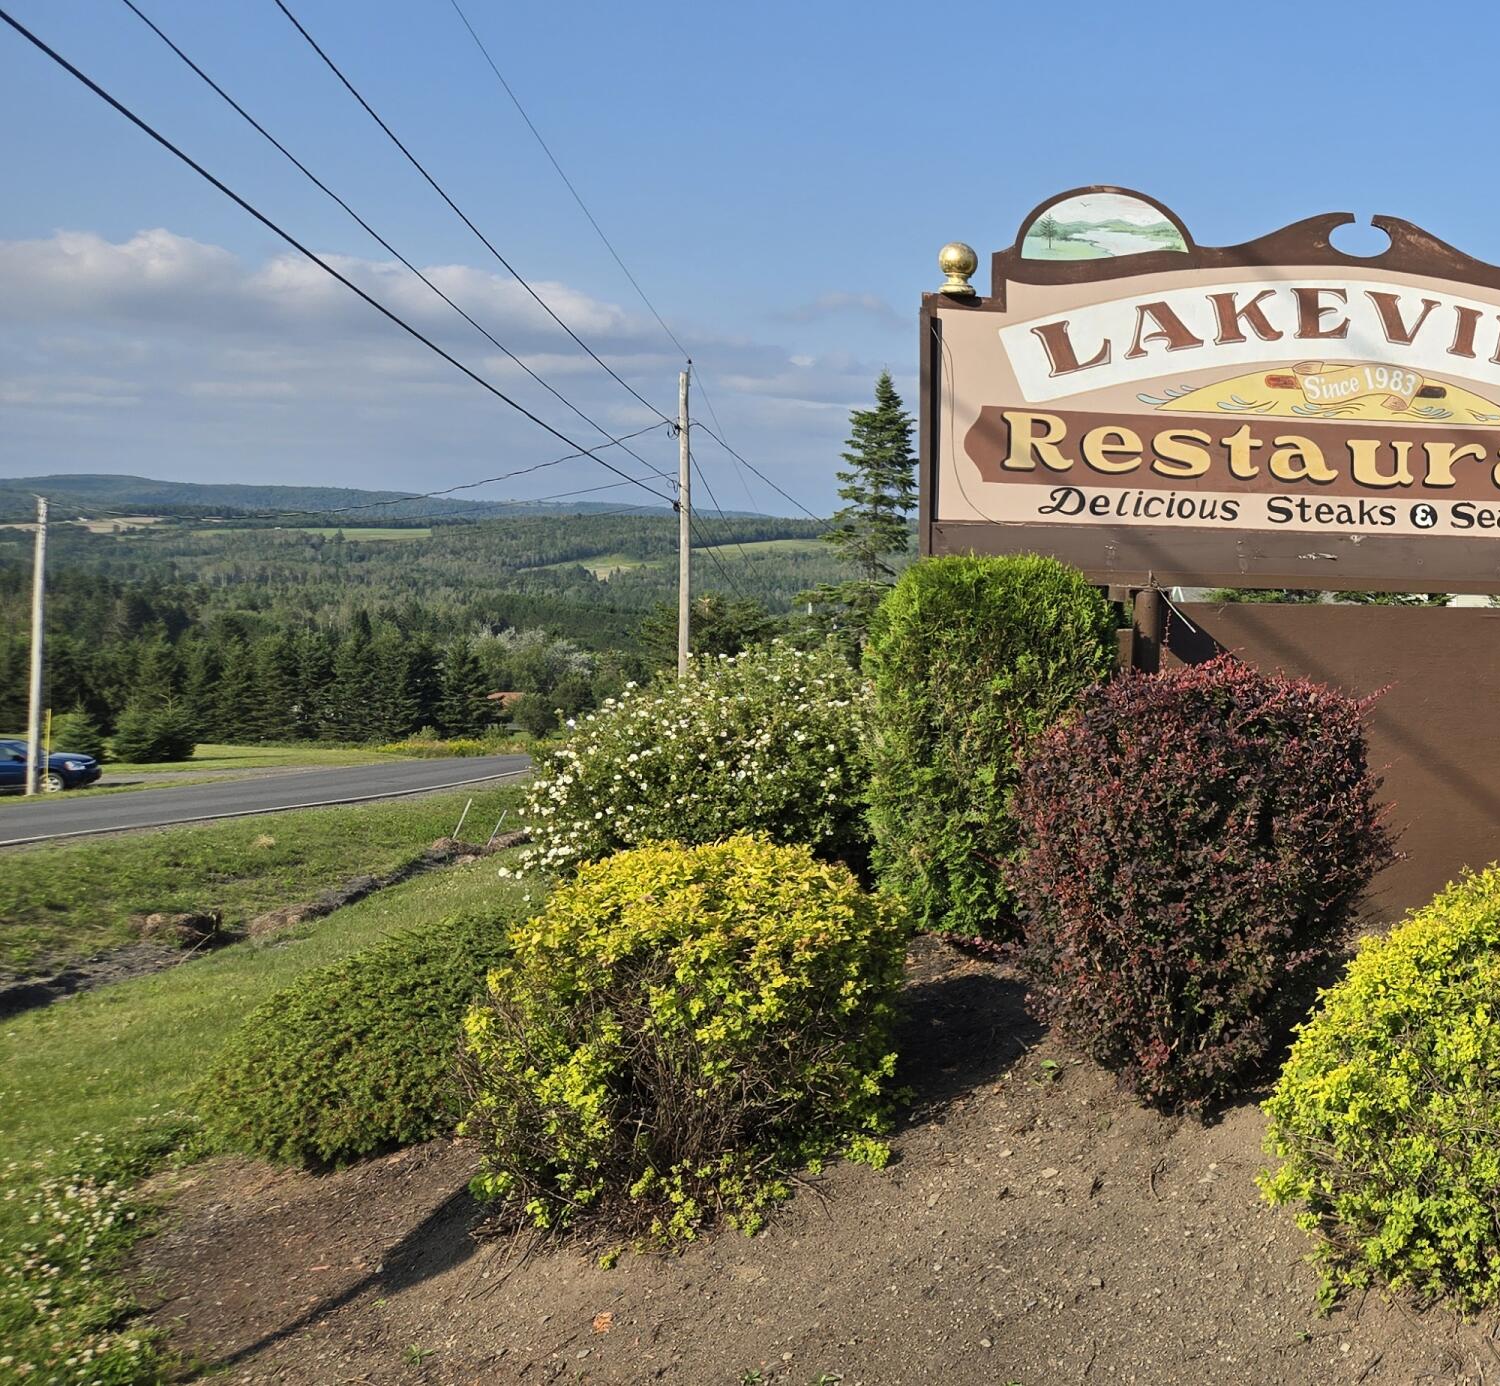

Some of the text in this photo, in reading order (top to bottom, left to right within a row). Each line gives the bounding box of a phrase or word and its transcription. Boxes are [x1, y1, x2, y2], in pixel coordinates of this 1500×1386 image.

[1303, 366, 1417, 400] Since 1983
[1037, 486, 1241, 522] Delicious
[1266, 496, 1397, 526] Steaks
[1412, 504, 1437, 528] &
